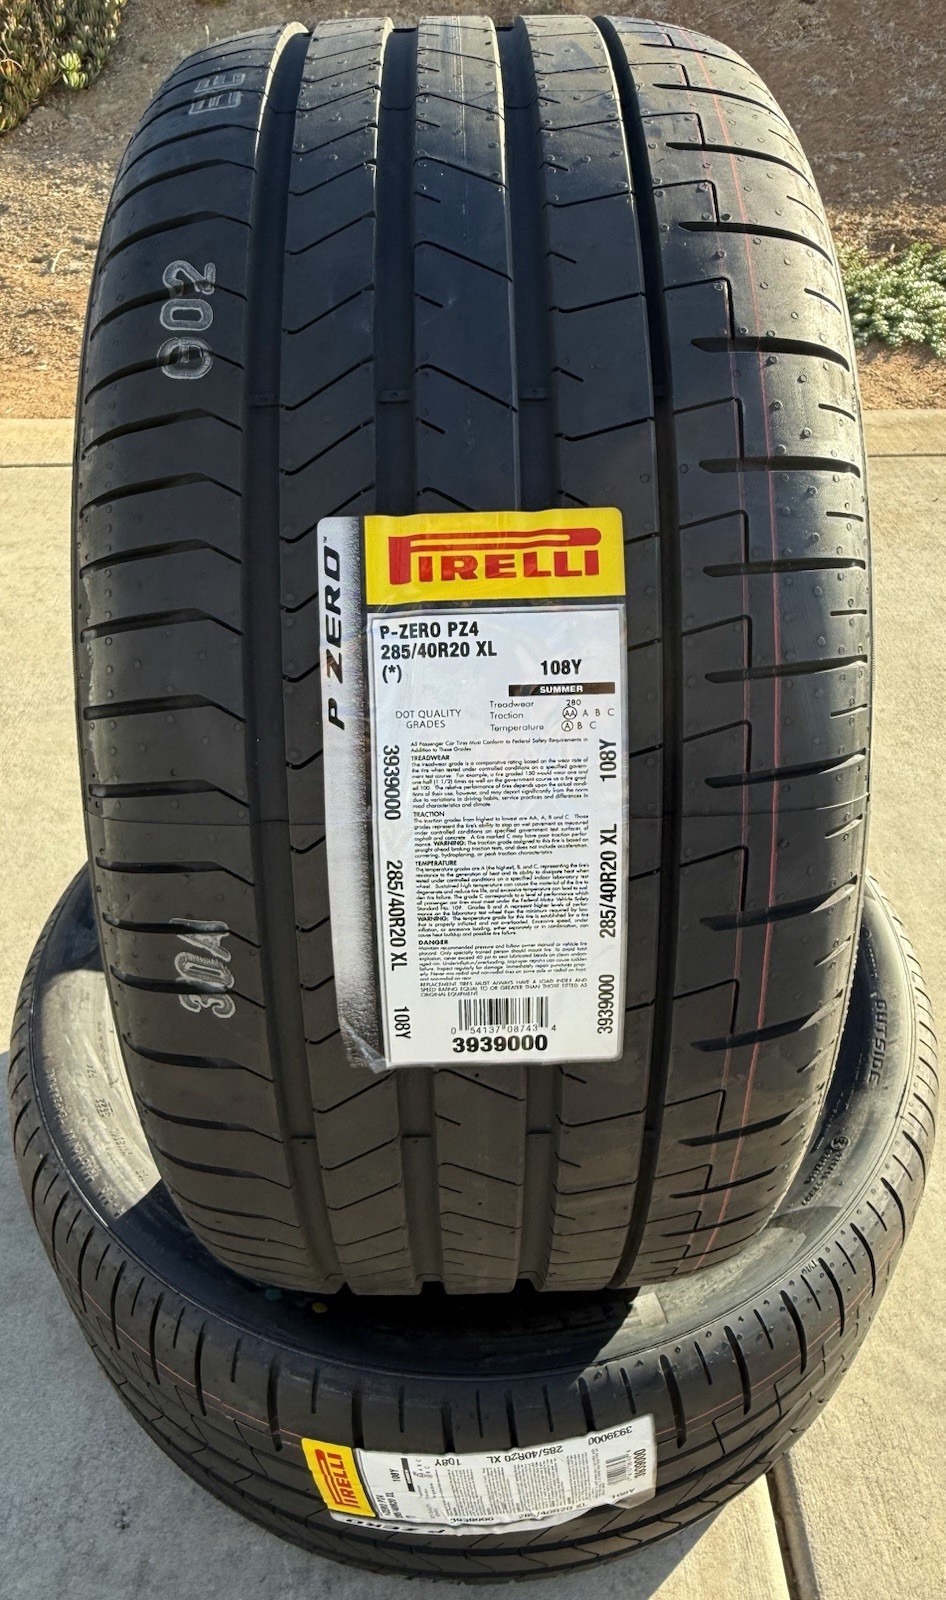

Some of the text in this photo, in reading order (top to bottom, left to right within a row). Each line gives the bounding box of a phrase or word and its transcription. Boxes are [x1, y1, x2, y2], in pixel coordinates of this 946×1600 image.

[388, 527, 602, 585] PIRELLI
[323, 546, 345, 730] P ZERO
[379, 621, 479, 639] P-ZERO PZ4
[380, 640, 497, 660] 285/40R20 XL
[540, 659, 582, 676] 108Y
[540, 684, 583, 693] SUMMER
[489, 699, 582, 708] Treadwear 280
[395, 709, 461, 719] DOT QUALITY
[490, 711, 524, 719] Traction
[582, 709, 589, 717] A
[607, 708, 615, 716] C
[406, 720, 446, 729] GRADES
[490, 724, 544, 733] Temperature
[589, 721, 597, 729] C
[599, 738, 617, 782] 108Y
[383, 744, 401, 821] 3939000
[599, 823, 617, 938] 285/40R20 XL
[387, 860, 408, 971] 285/40R20 XL
[597, 974, 615, 1034] 3939000
[393, 1006, 411, 1039] 108Y
[451, 1027, 457, 1035] 0
[470, 1025, 500, 1034] 54137
[507, 1024, 538, 1033] 08743
[453, 1034, 548, 1053] 3939000
[866, 998, 887, 1085] OUTSIDE
[588, 1425, 633, 1446] 3939000
[435, 1457, 461, 1466] 108Y
[486, 1445, 564, 1464] 285/40R20 XL
[315, 1449, 361, 1509] PIRELLI
